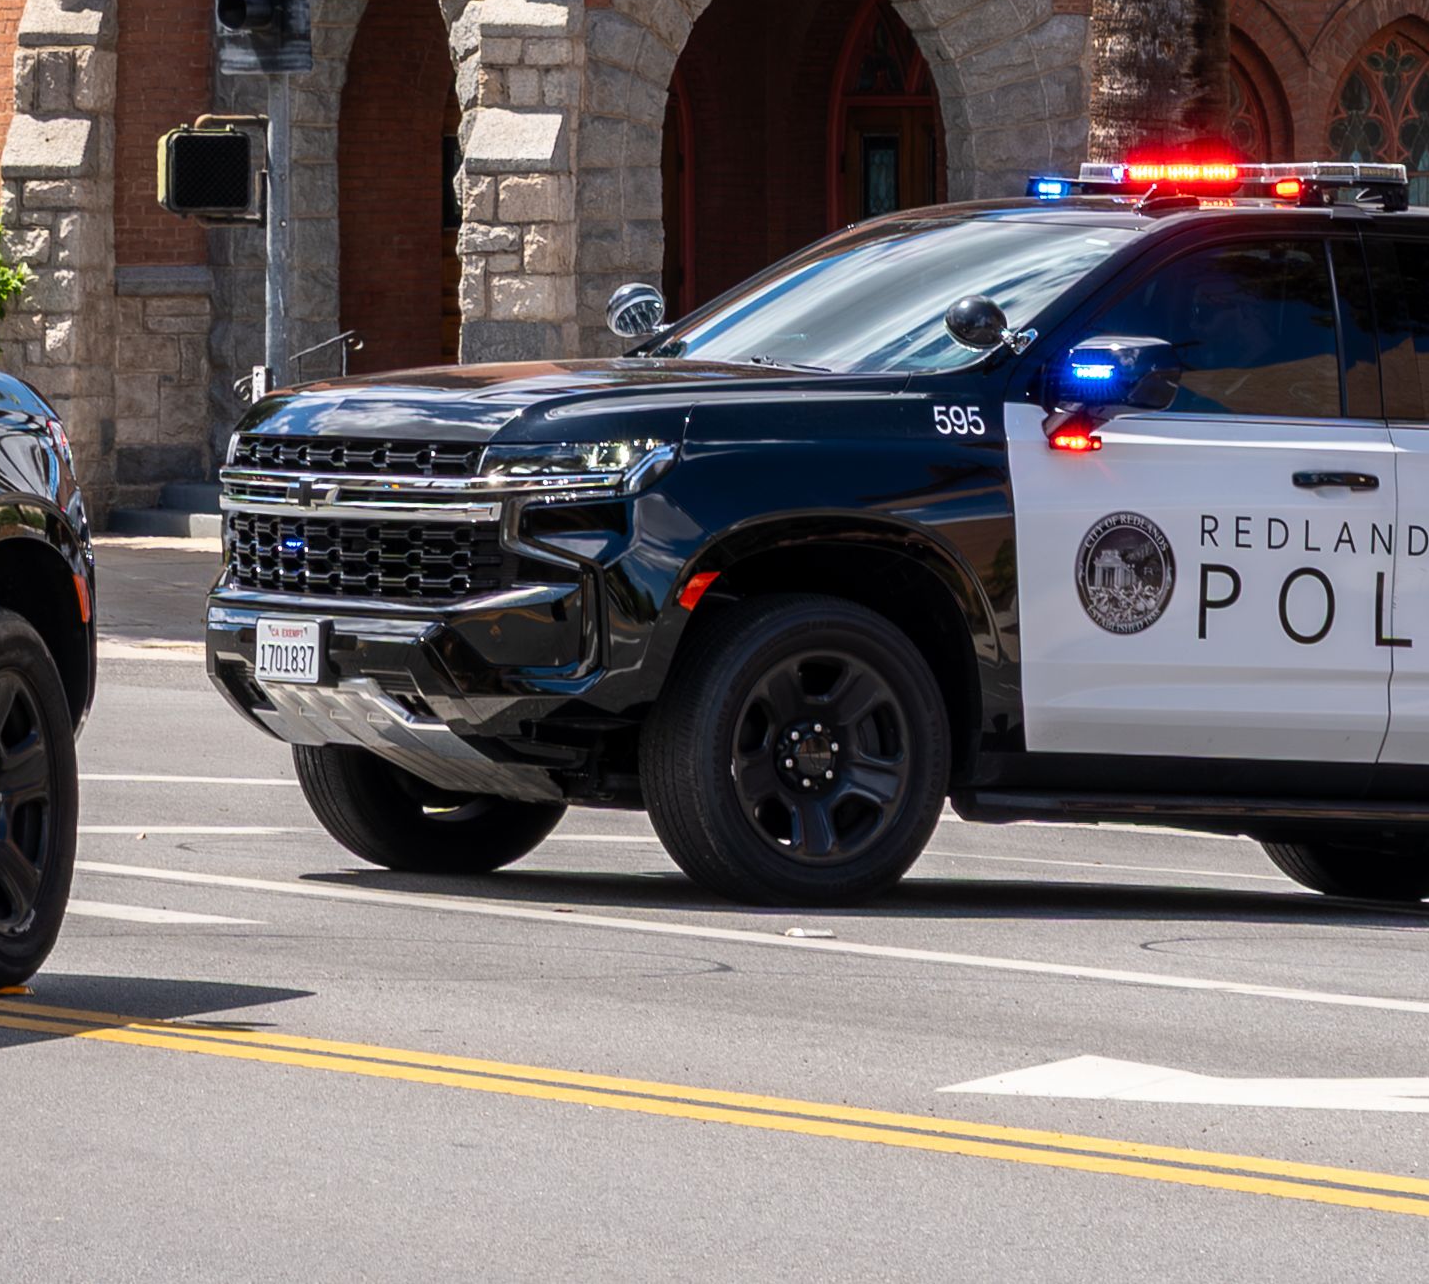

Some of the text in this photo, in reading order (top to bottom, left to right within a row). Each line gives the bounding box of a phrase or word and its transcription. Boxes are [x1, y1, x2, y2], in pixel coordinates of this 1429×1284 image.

[933, 405, 986, 435] 595
[1085, 514, 1170, 552] CITY OF REDLANDS
[271, 627, 304, 638] CA EXEMPT
[260, 643, 315, 674] 1701837
